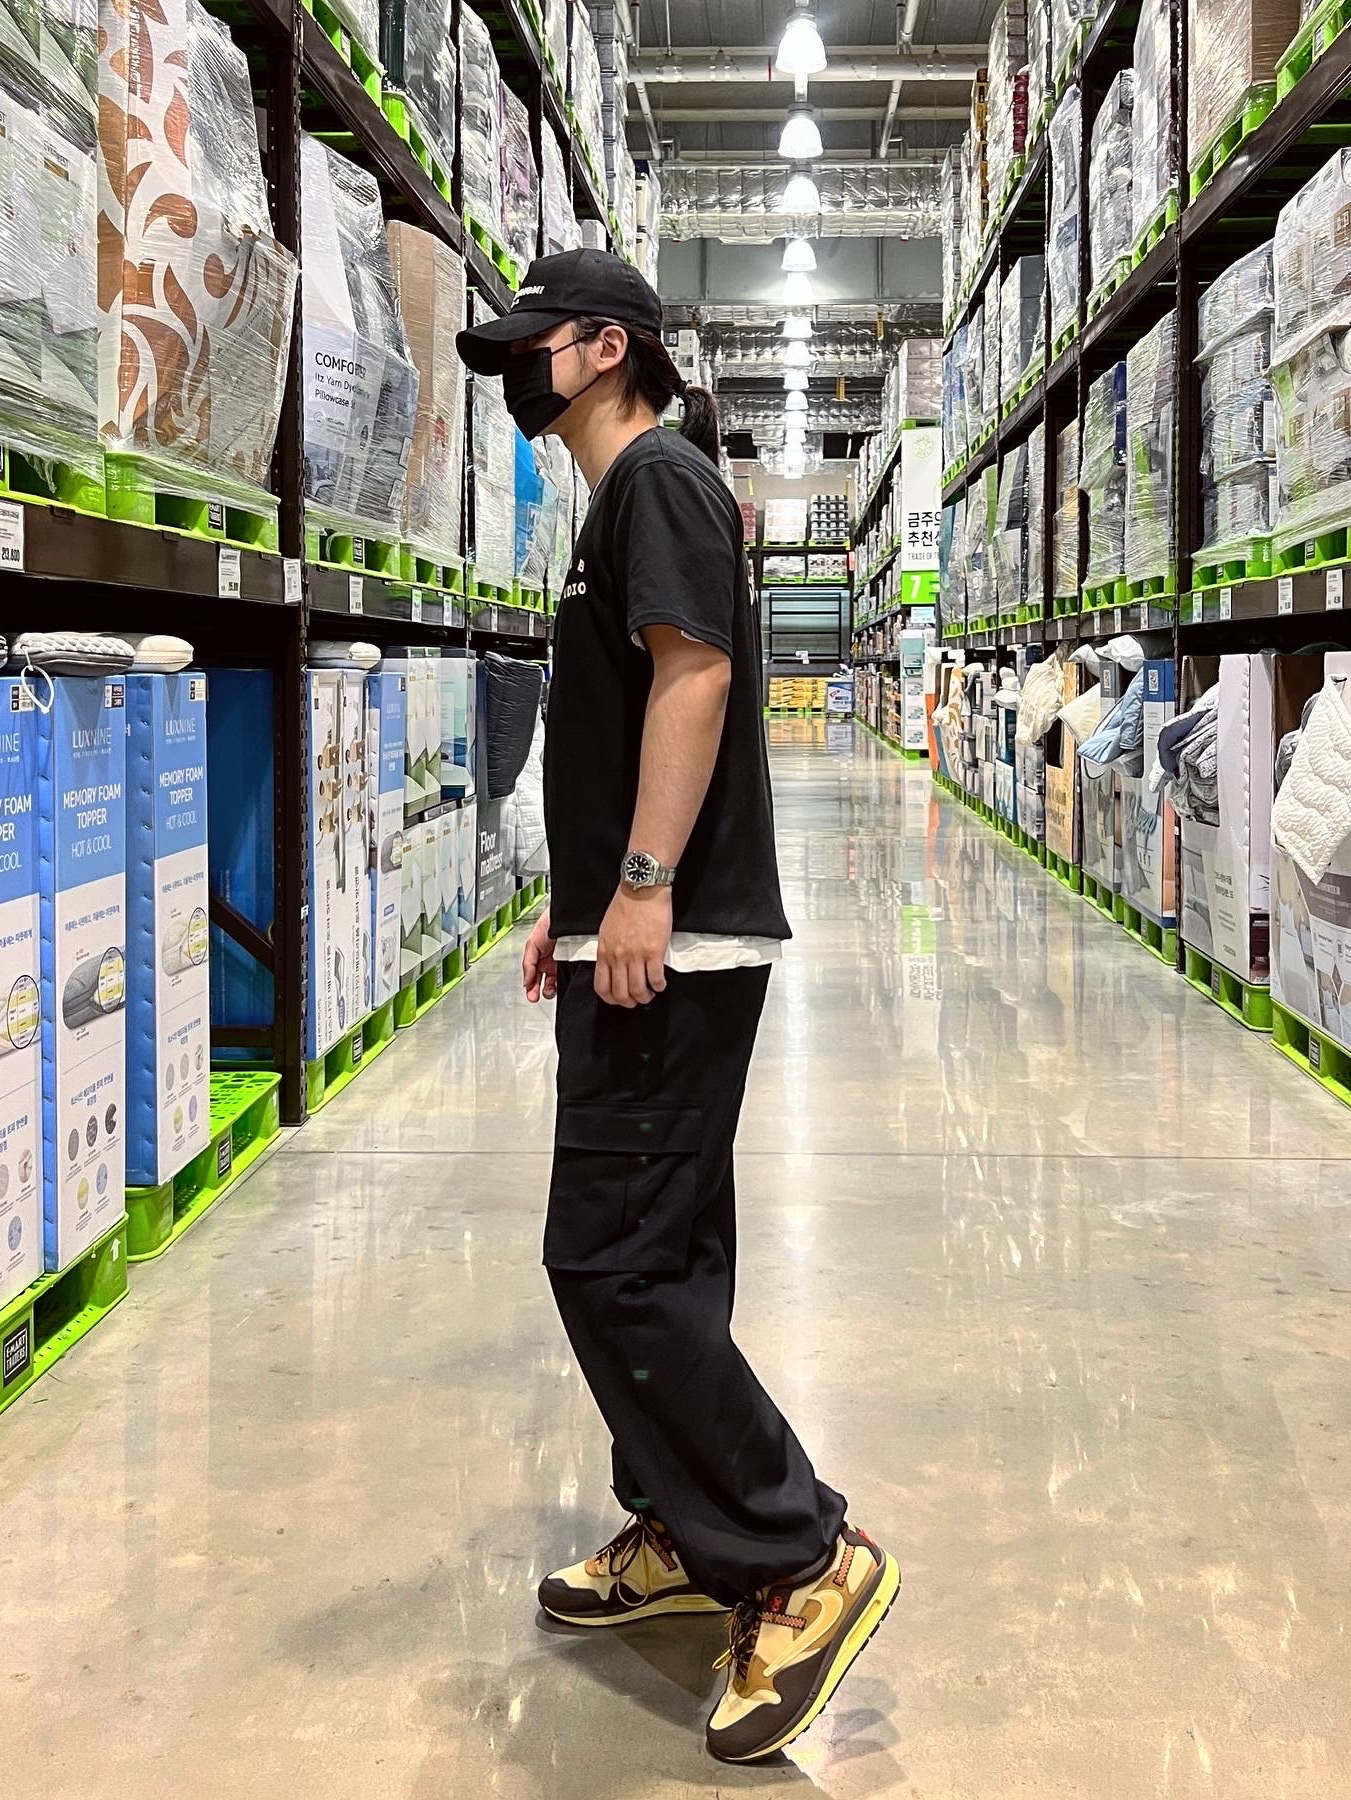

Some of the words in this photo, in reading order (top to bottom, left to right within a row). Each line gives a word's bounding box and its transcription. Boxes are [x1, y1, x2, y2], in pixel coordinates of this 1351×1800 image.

[327, 376, 342, 389] Yarn
[315, 388, 350, 408] Pillowcase
[910, 575, 922, 599] 7
[165, 717, 197, 736] LUXNINE
[72, 727, 112, 749] LUXNINE
[159, 768, 186, 789] MEMORY
[185, 766, 204, 784] FOAM
[4, 793, 32, 816] FOAM
[63, 787, 98, 809] MEMORY
[98, 783, 121, 802] FOAM
[169, 787, 194, 807] TOPPER
[76, 807, 108, 830] TOPPER
[181, 810, 198, 827] COOL
[71, 839, 86, 860] HOT
[86, 837, 92, 856] &
[92, 834, 113, 854] COOL
[481, 831, 496, 853] Floor
[481, 852, 503, 877] mattress
